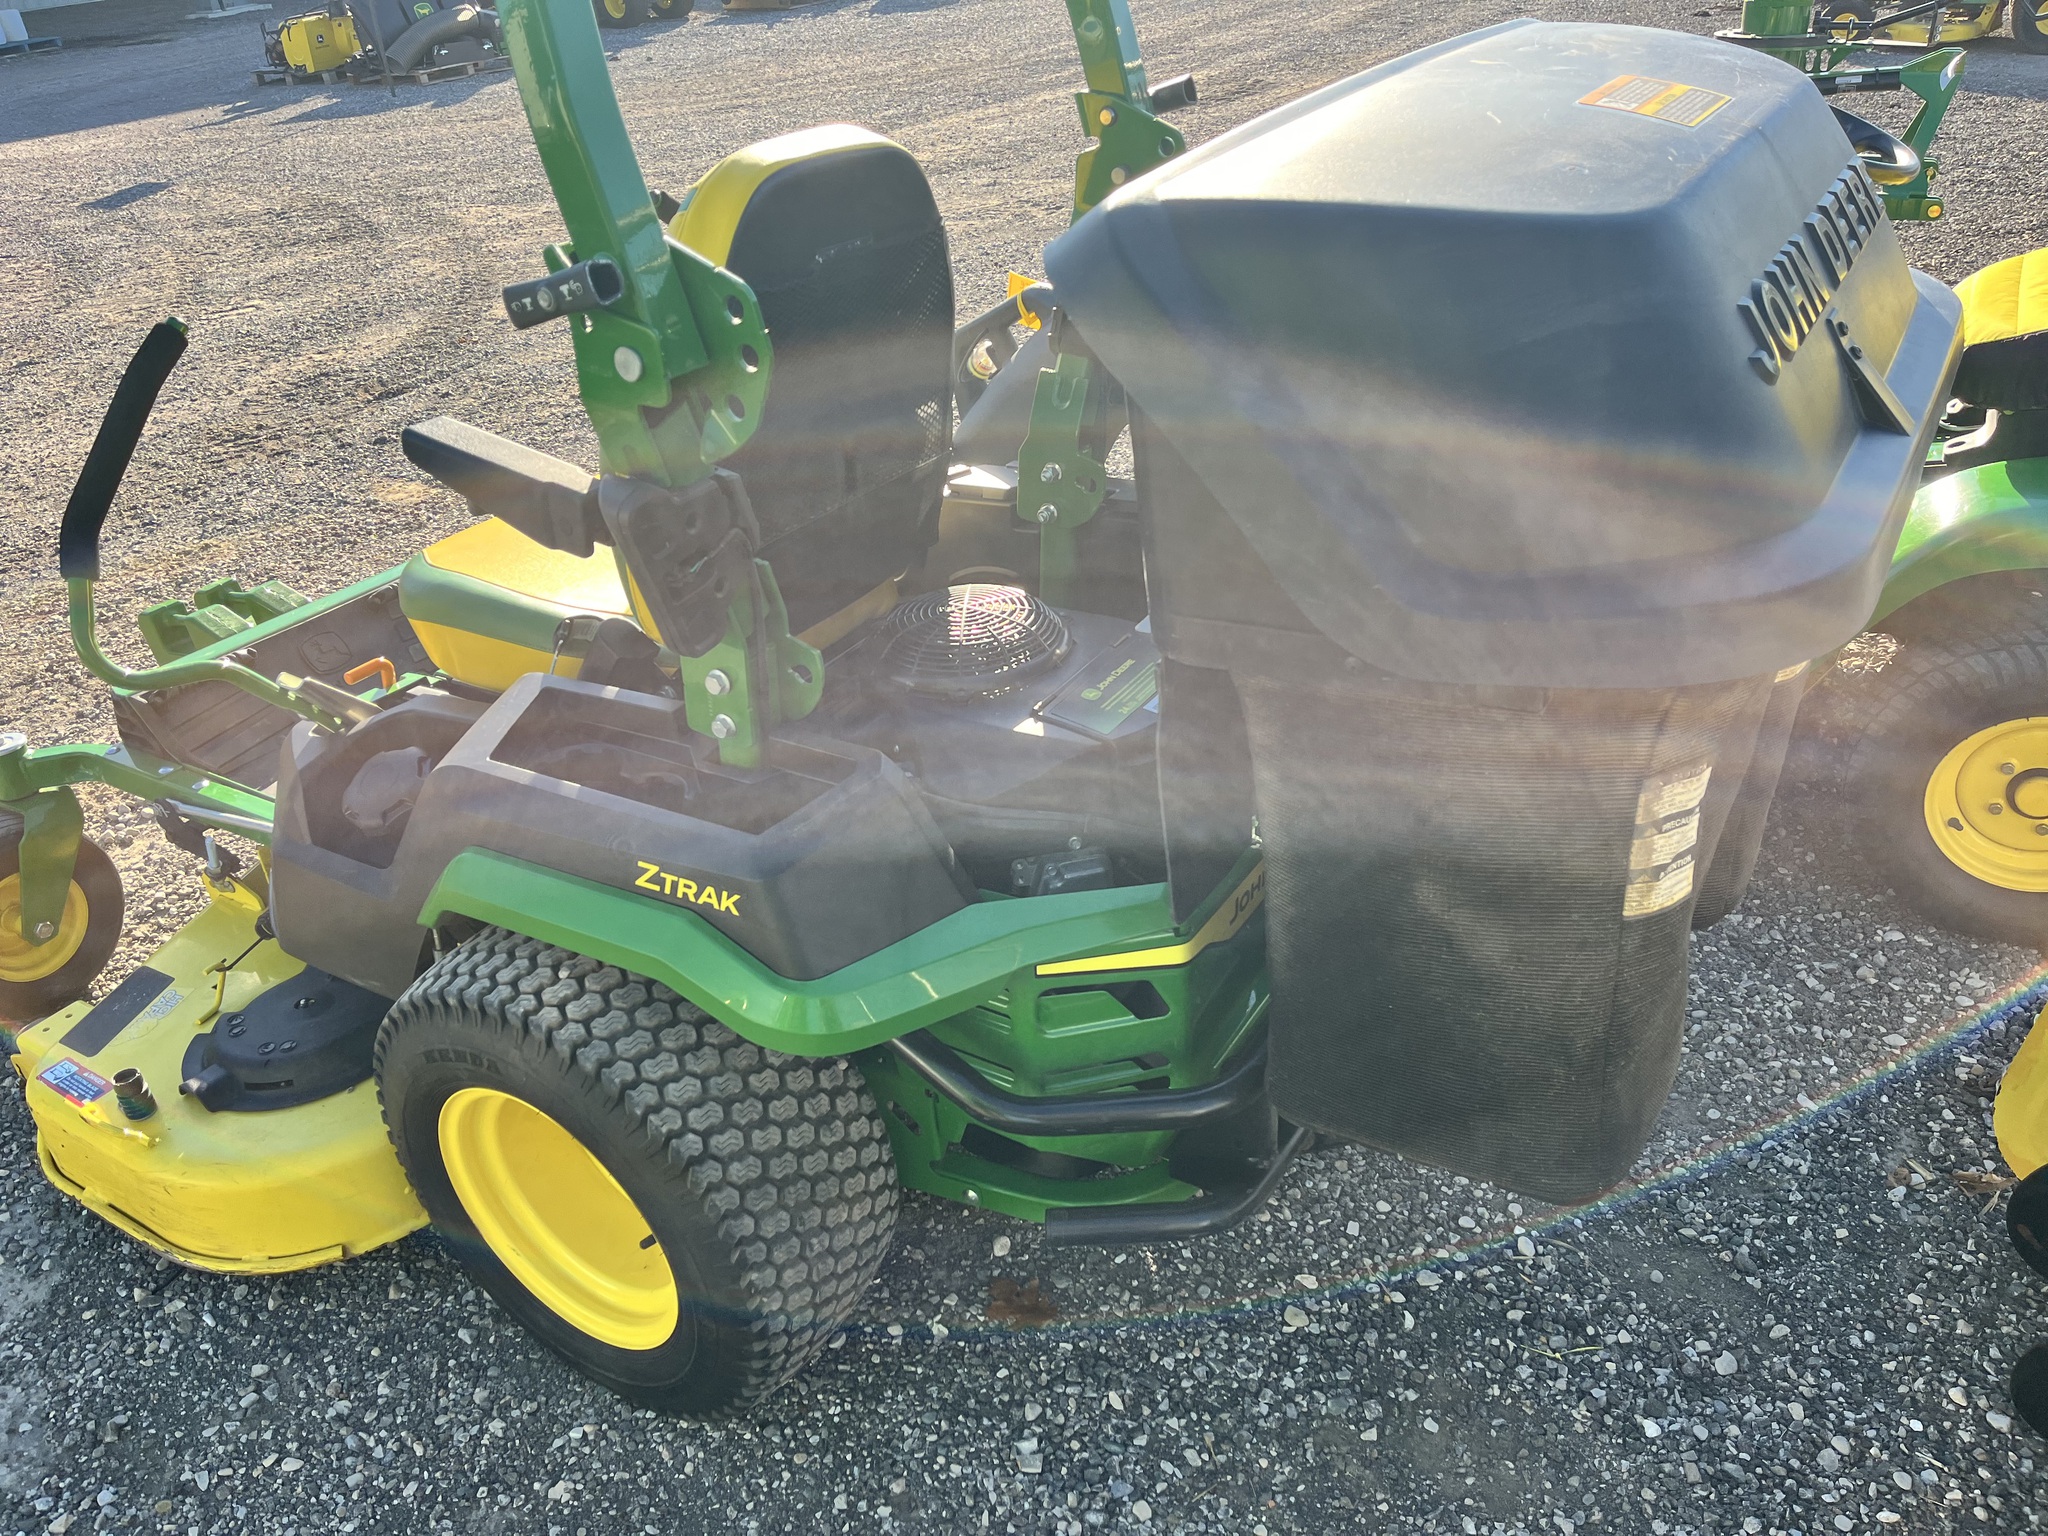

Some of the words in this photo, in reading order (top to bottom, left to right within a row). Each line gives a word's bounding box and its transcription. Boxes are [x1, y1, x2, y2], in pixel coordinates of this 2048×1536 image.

[1736, 234, 1831, 386] JOHN
[1803, 155, 1886, 291] DEERE
[1096, 675, 1119, 691] JOHN
[1111, 658, 1136, 677] DEERE
[634, 860, 741, 917] ZTRAK
